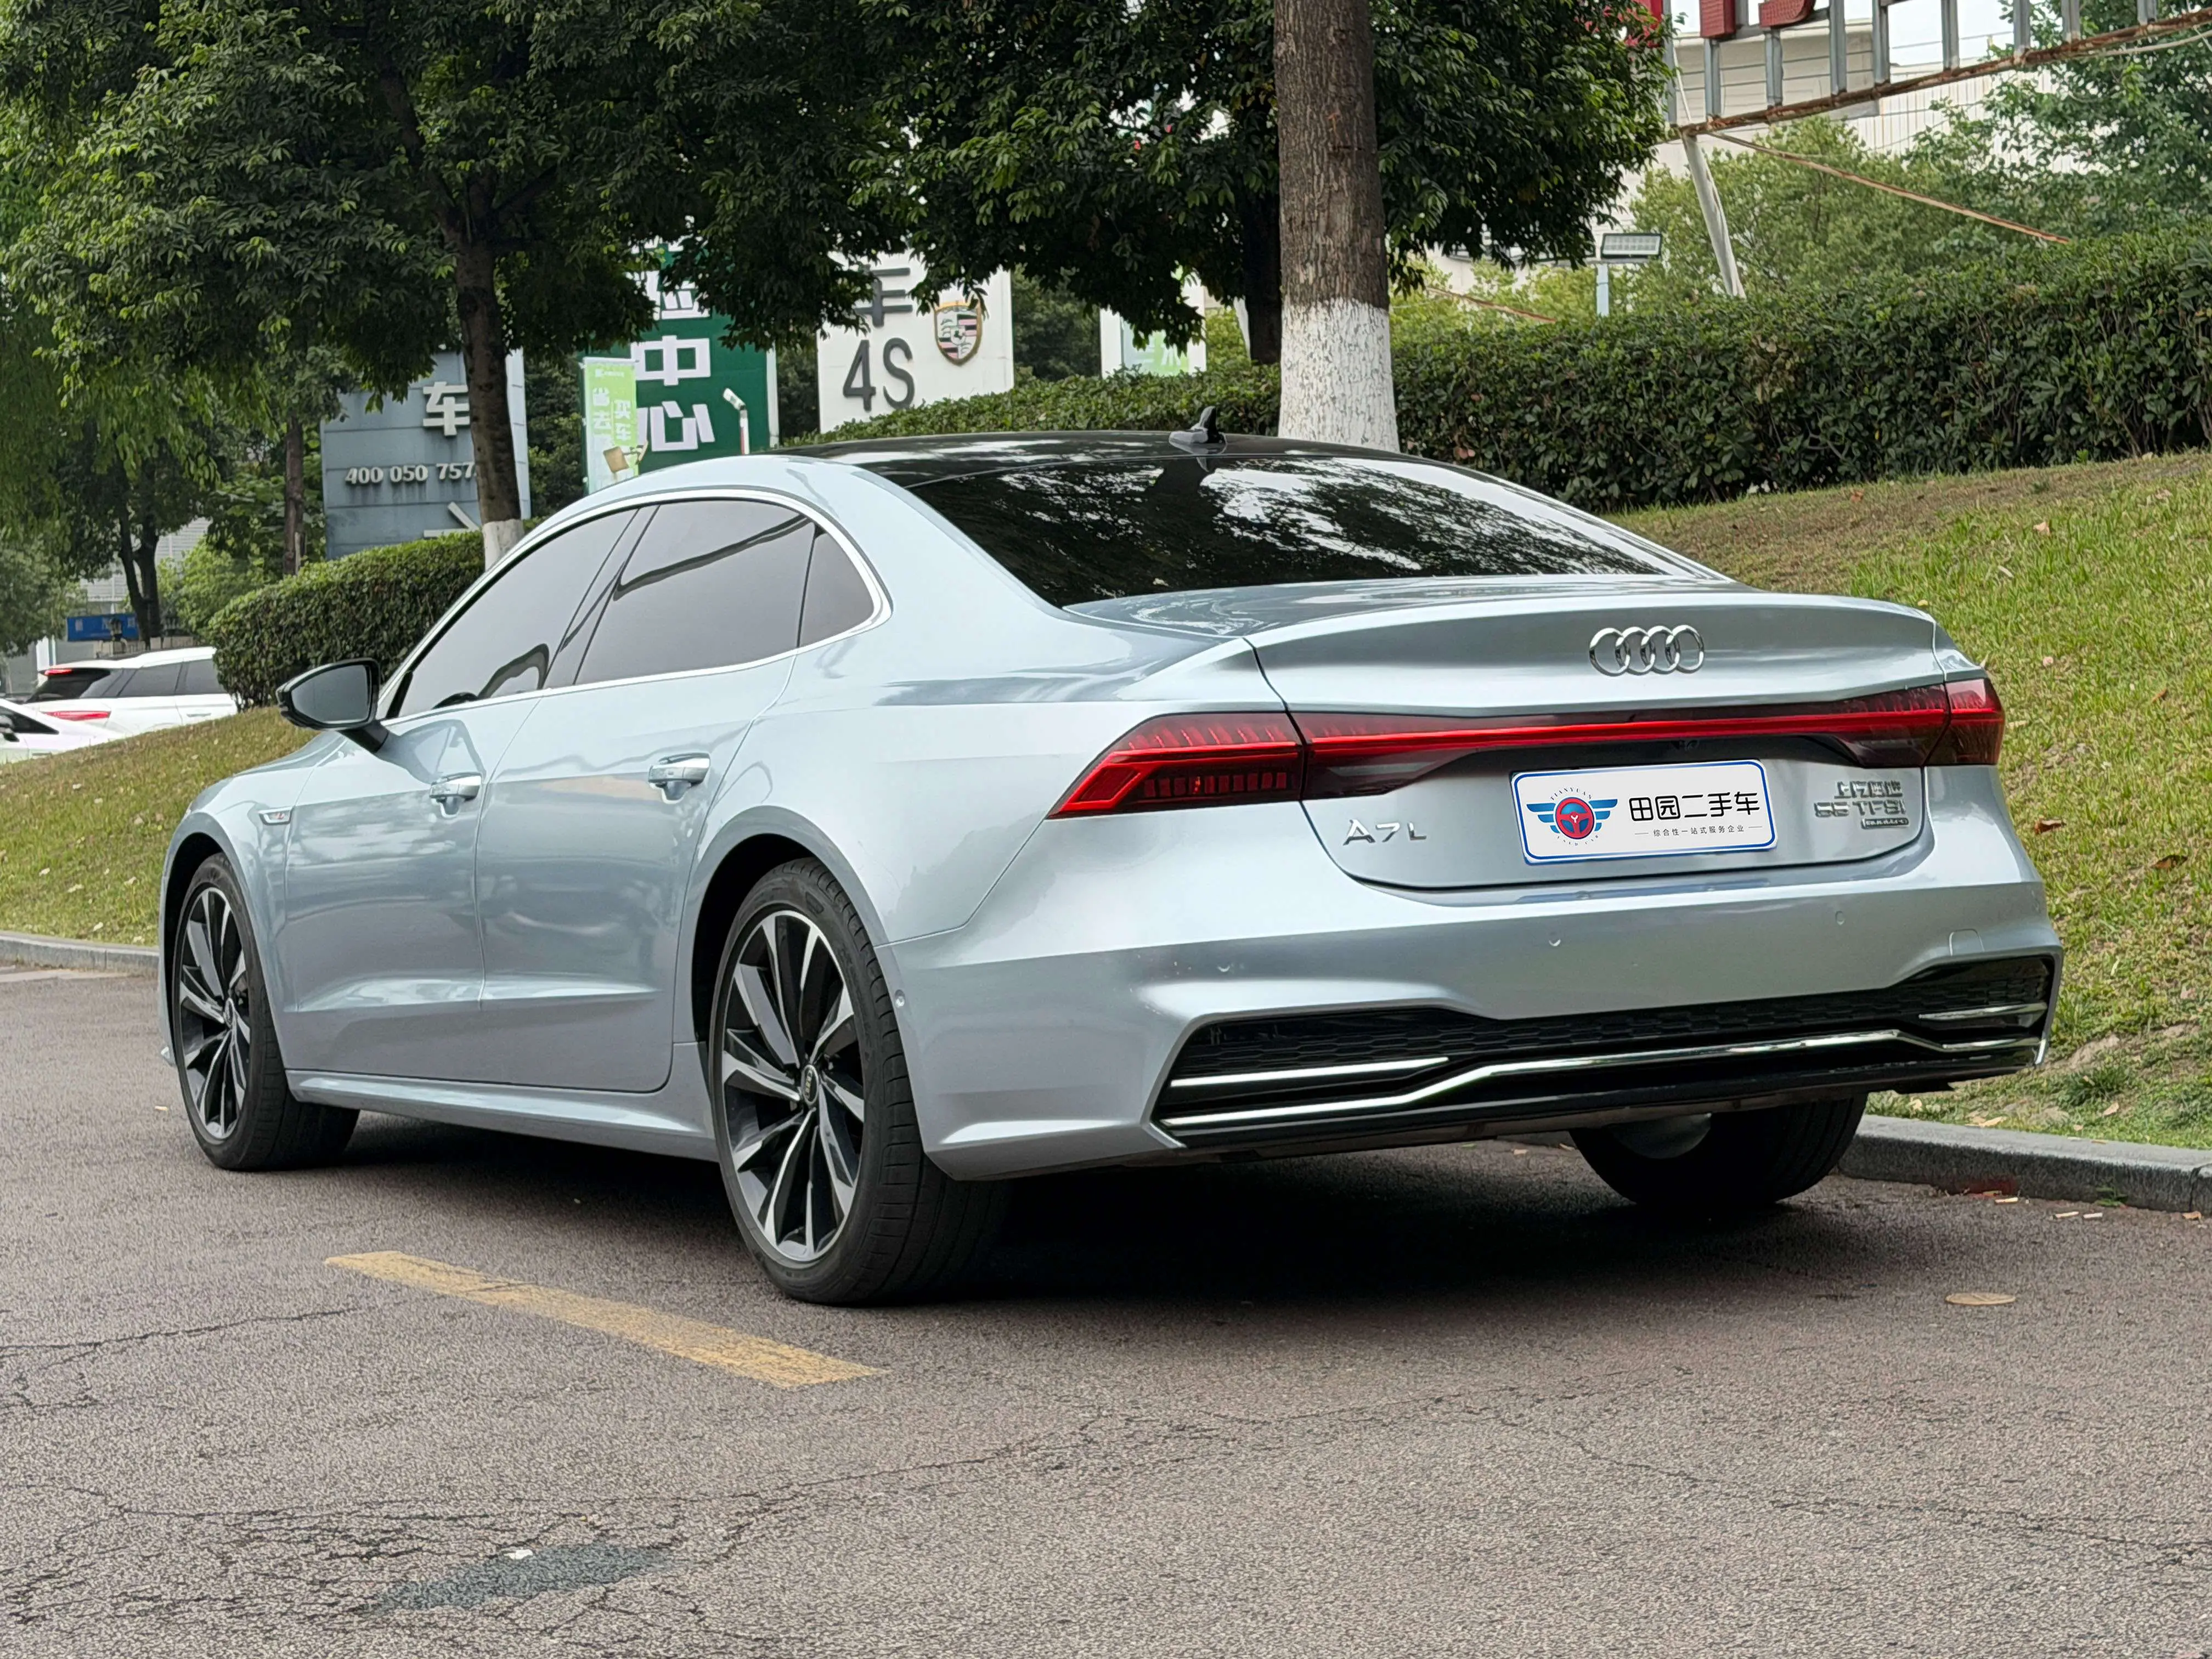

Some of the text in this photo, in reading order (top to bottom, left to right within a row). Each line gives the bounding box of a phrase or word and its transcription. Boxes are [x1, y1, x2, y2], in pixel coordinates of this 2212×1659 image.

[842, 337, 916, 413] 4S
[422, 381, 471, 436] 车
[345, 461, 477, 484] 400 050 757
[1628, 791, 1760, 822] 田园二手车
[1852, 799, 1906, 816] TFSI
[1342, 819, 1427, 846] A7L
[1652, 824, 1745, 837] 综合性一站式服务企业
